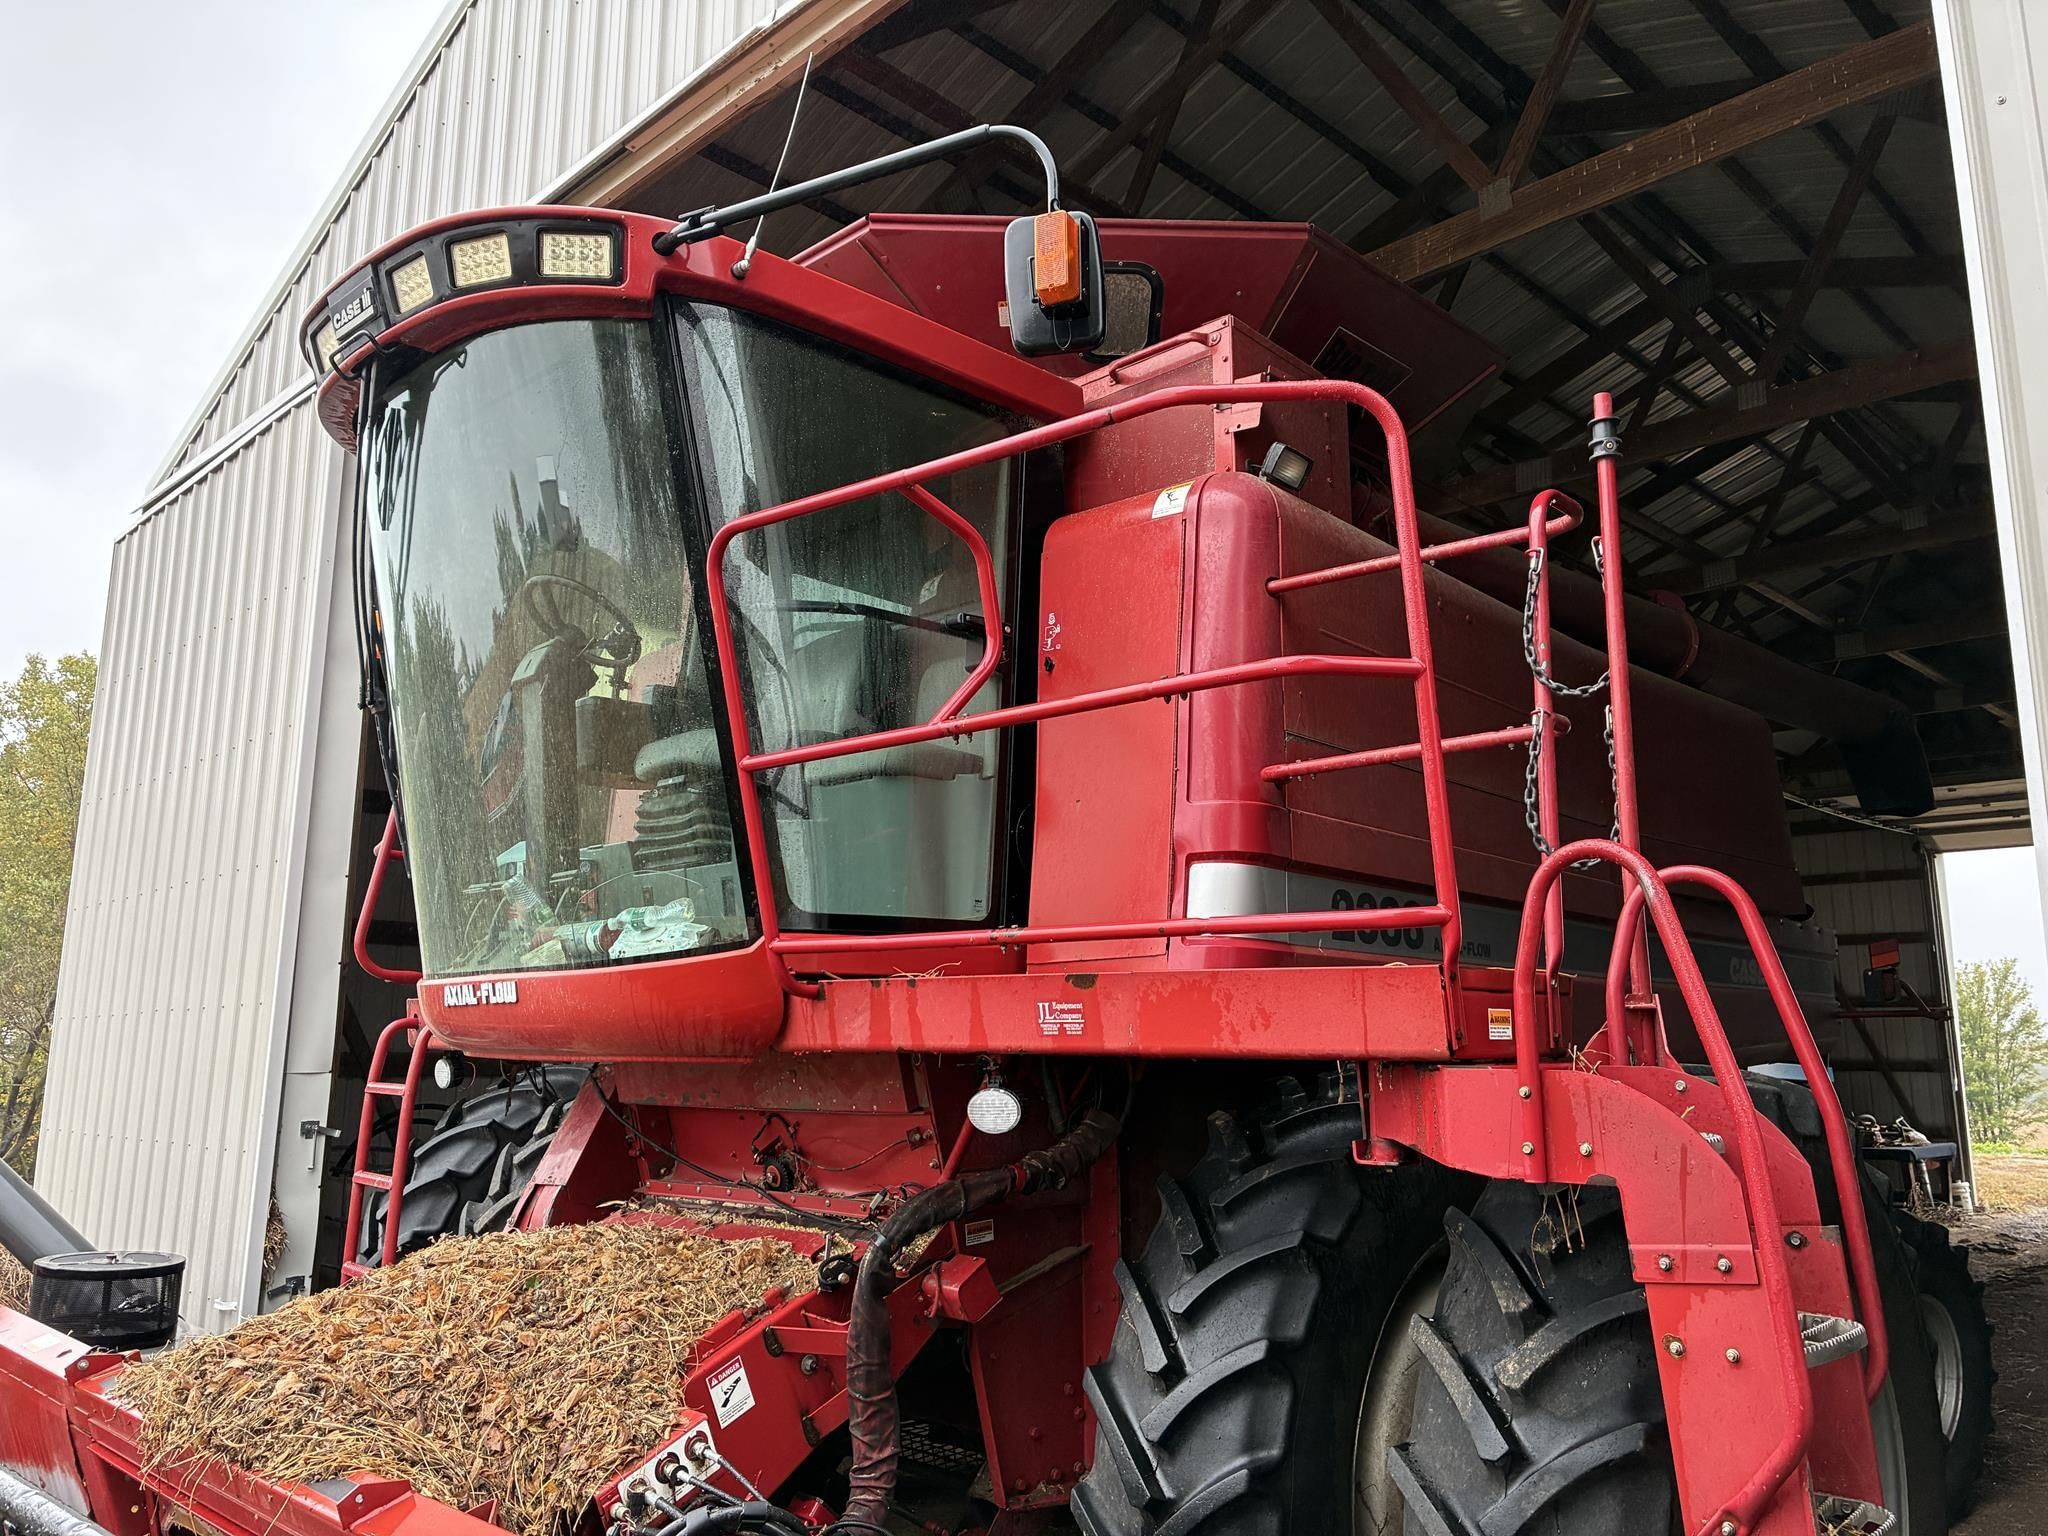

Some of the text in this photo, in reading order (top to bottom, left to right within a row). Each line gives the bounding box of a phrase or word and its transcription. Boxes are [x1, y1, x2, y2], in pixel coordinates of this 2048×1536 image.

[333, 298, 361, 329] CASE
[444, 981, 518, 1007] AXIAL-FLOW
[1037, 1001, 1083, 1023] JL Equipment
[1055, 1011, 1082, 1021] Company
[718, 1362, 741, 1382] DANGER
